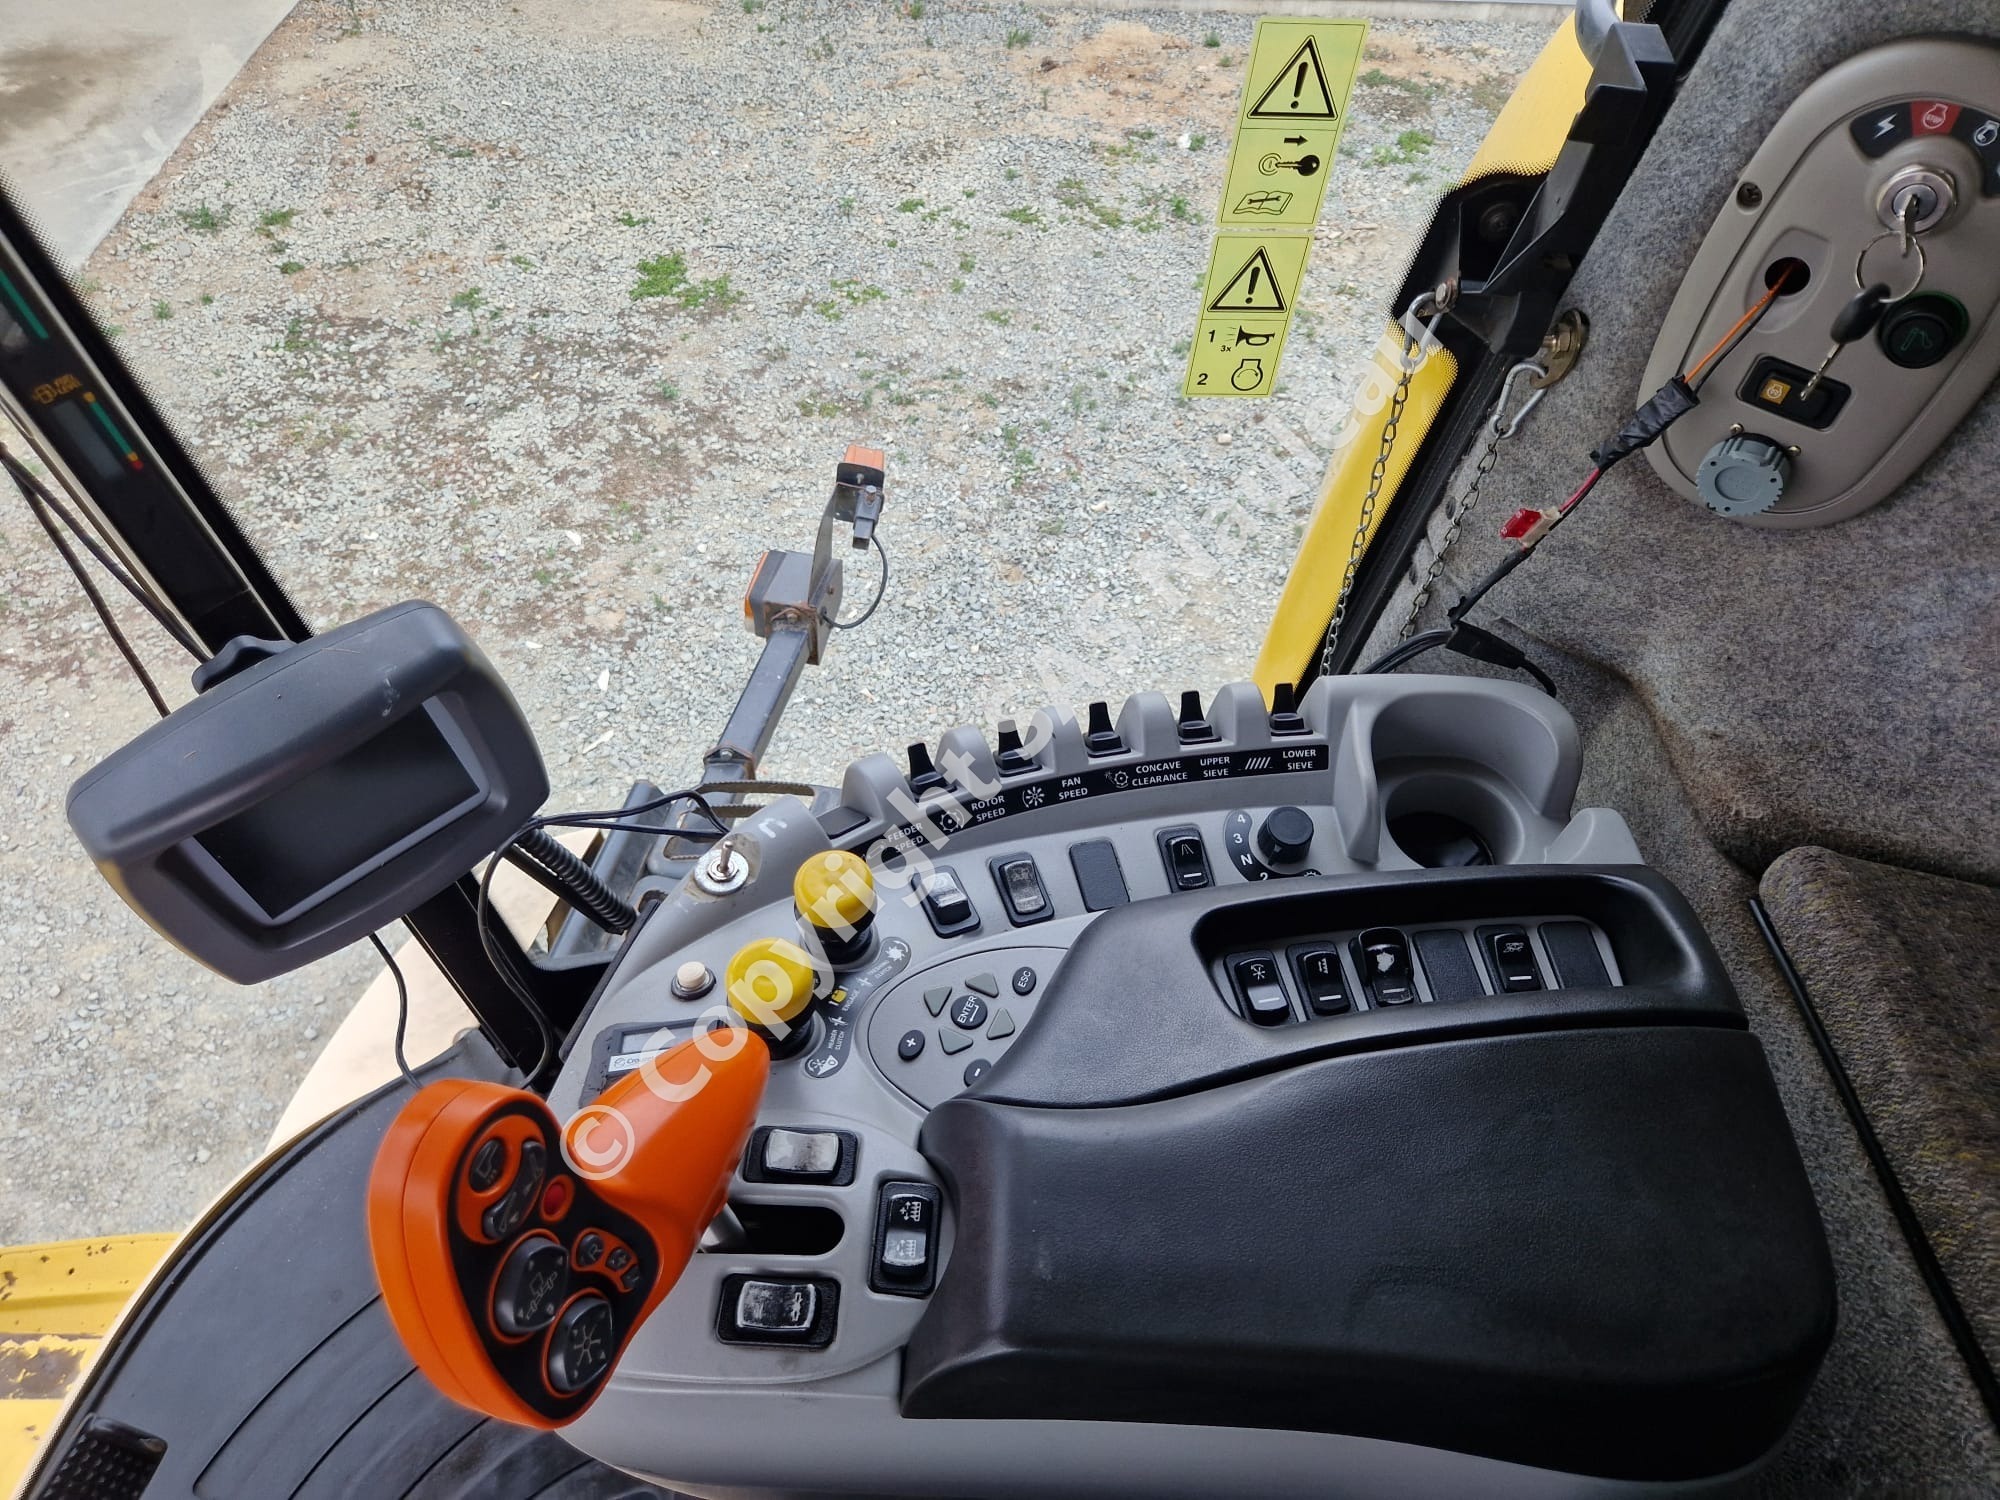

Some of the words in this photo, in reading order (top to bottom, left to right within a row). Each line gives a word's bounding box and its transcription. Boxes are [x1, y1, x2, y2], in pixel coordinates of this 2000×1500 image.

[1208, 329, 1216, 343] 1
[1197, 373, 1208, 385] 2
[1282, 749, 1317, 759] LOWER
[1135, 760, 1181, 774] CONCAVE
[1199, 756, 1230, 767] UPPER
[1287, 761, 1313, 771] SIEVE
[1131, 771, 1188, 787] CLEARANCE
[1203, 768, 1229, 778] SIEVE
[1061, 776, 1081, 788] FAN
[1058, 787, 1088, 800] SPEED
[971, 795, 1005, 811] ROTOR
[976, 807, 1006, 822] SPEED
[887, 822, 923, 842] FEEDER
[1233, 833, 1243, 844] 3
[895, 835, 924, 853] SPEED
[1240, 853, 1253, 866] N
[1017, 970, 1031, 988] ESC
[957, 995, 977, 1024] ENTER
